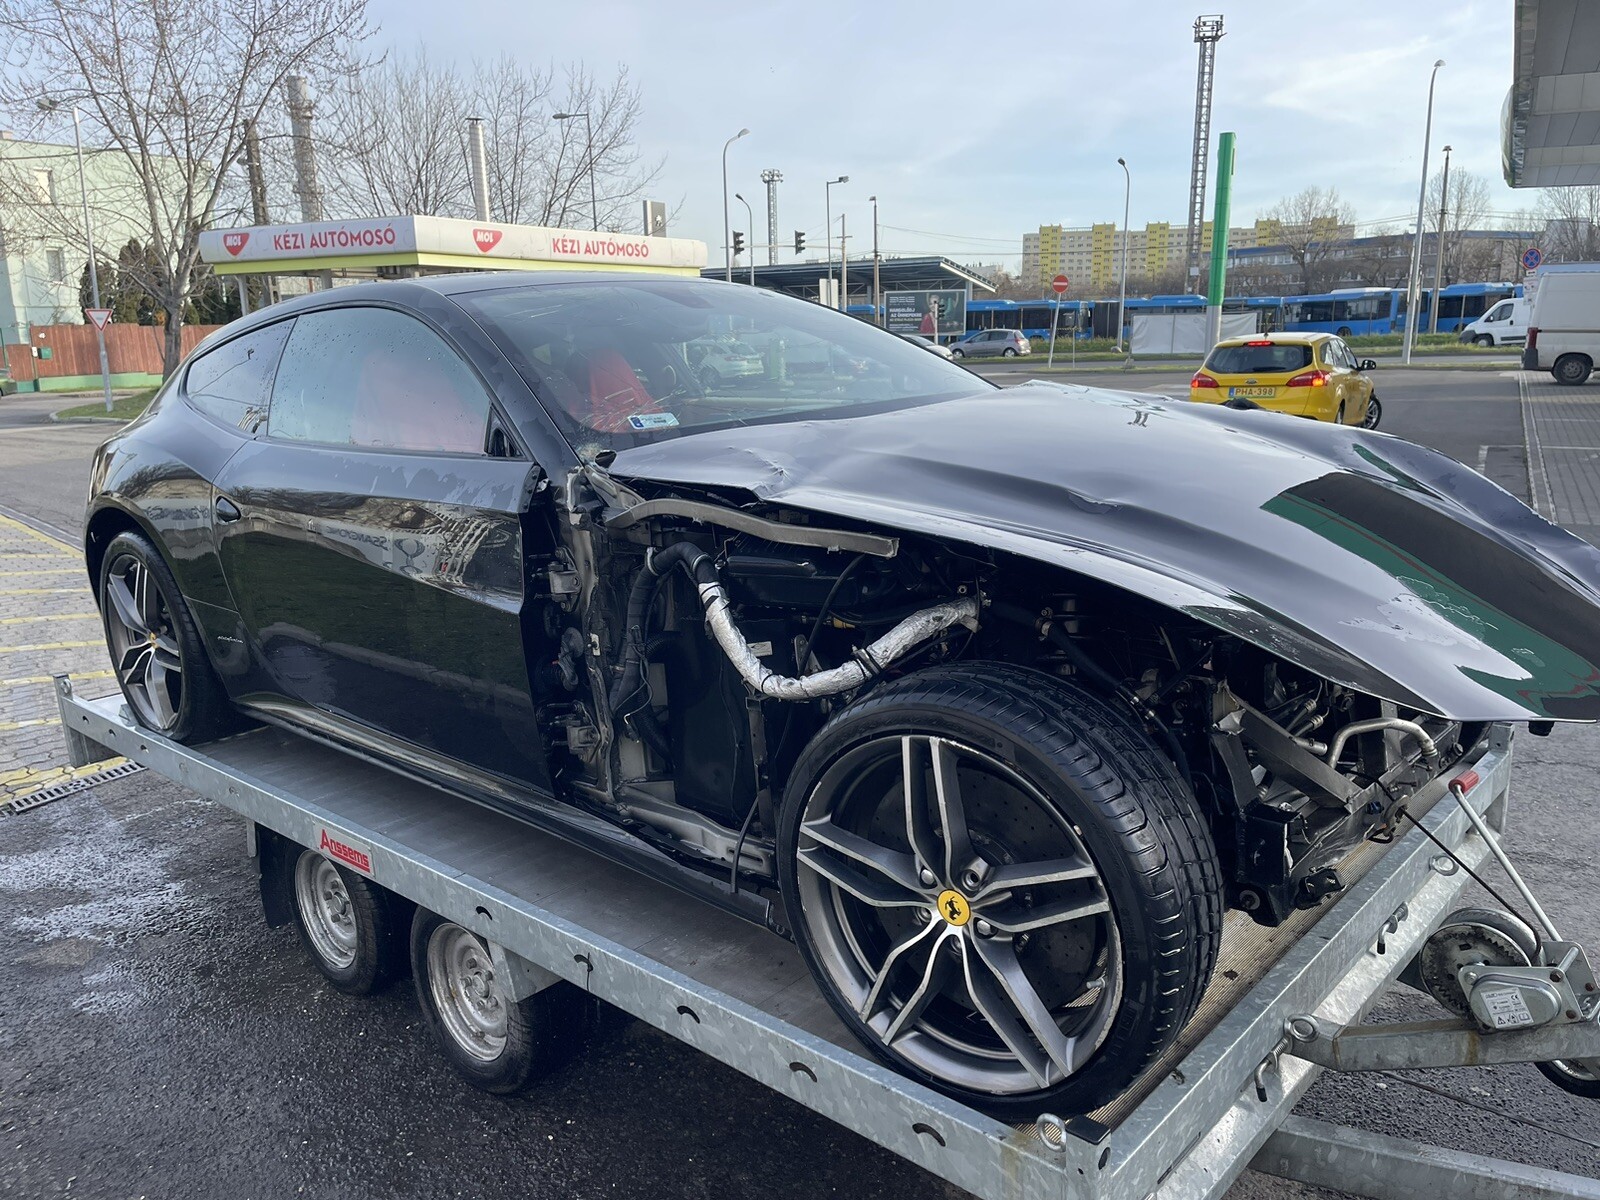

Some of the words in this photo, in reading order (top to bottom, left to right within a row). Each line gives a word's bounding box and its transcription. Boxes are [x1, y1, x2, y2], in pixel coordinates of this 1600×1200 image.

[226, 234, 242, 247] MOL
[273, 228, 305, 250] KÉZI
[310, 223, 396, 249] AUTÓMOSÓ
[476, 231, 494, 242] MOL
[552, 234, 580, 255] KÉZI
[584, 238, 649, 258] AUTÓMOSÓ
[1235, 388, 1273, 396] PHA-398
[320, 829, 370, 870] Anssems
